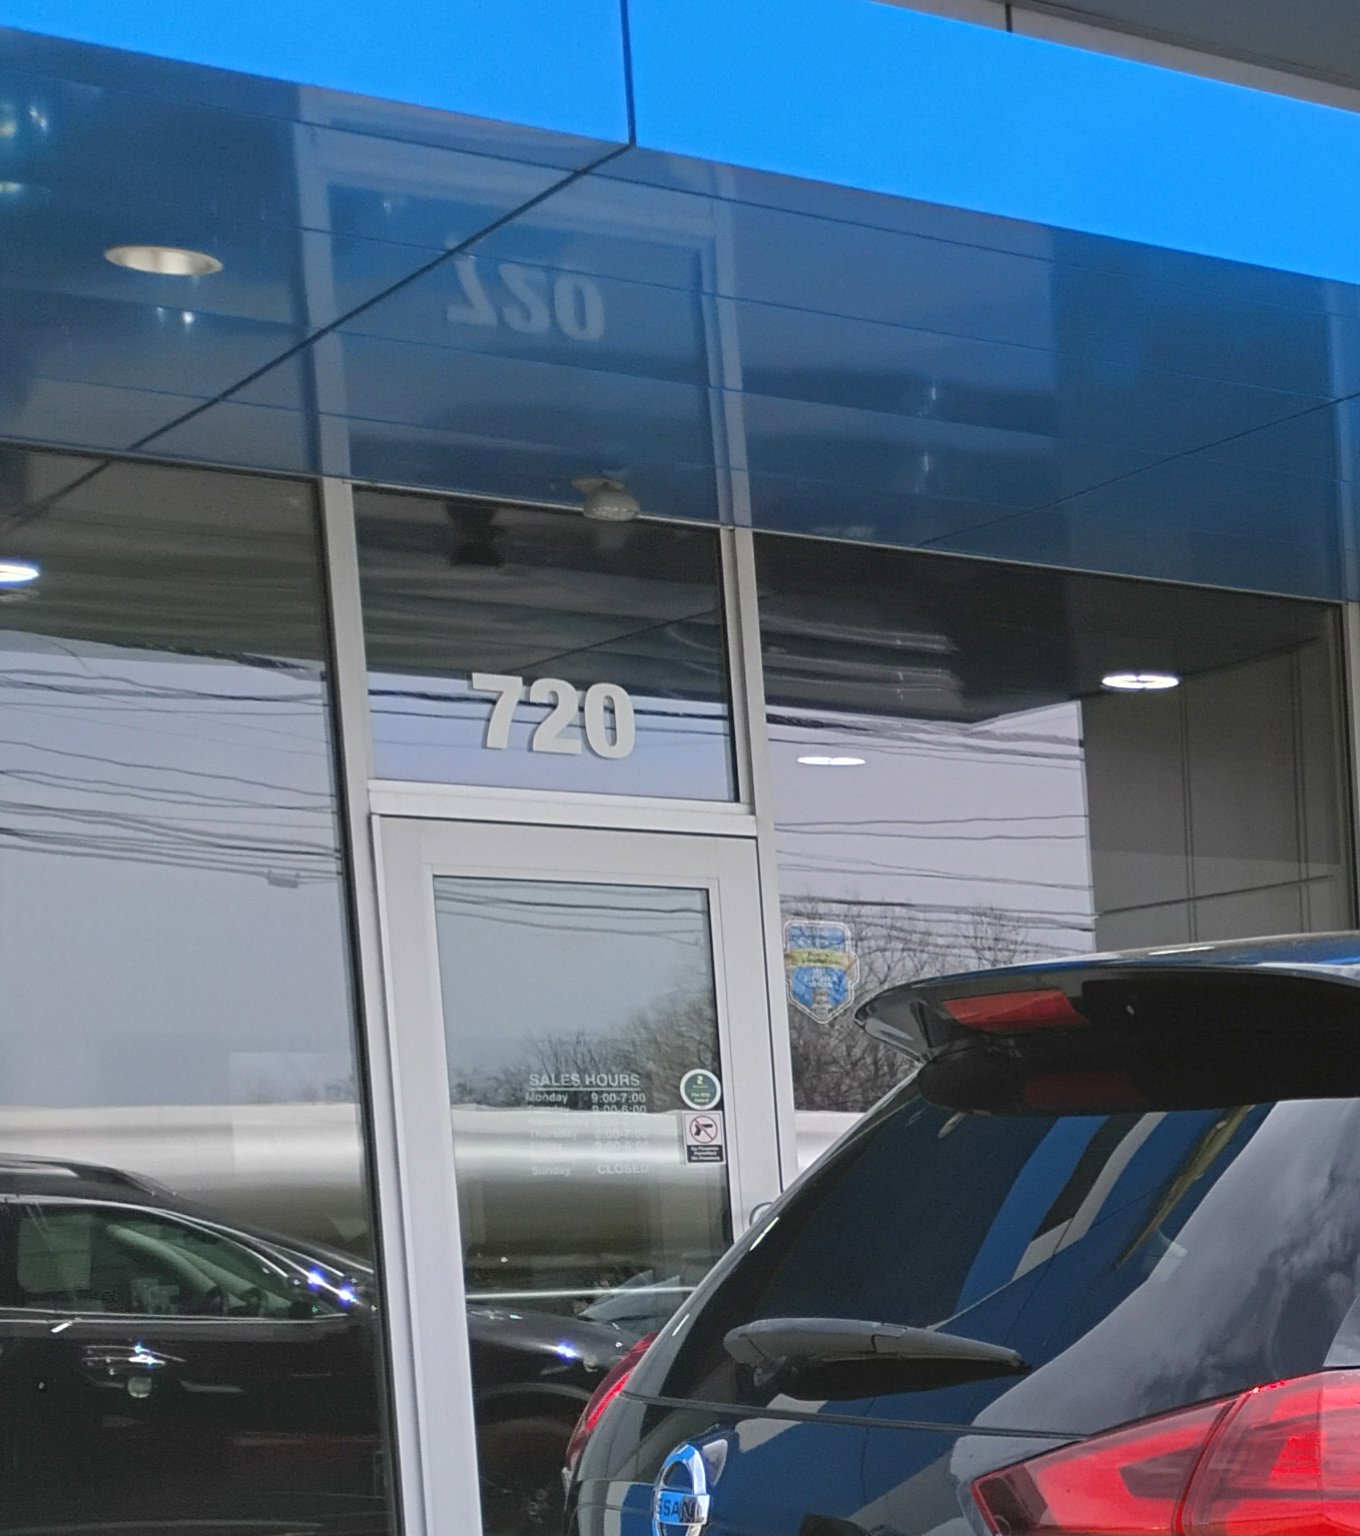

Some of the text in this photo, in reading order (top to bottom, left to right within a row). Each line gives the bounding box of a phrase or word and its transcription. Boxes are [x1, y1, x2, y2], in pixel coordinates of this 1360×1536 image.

[472, 672, 635, 759] 720
[529, 1074, 640, 1087] SALES HOURS
[526, 1092, 646, 1104] Monday 9:00-7:00
[531, 1164, 649, 1176] Sunday CLOSED
